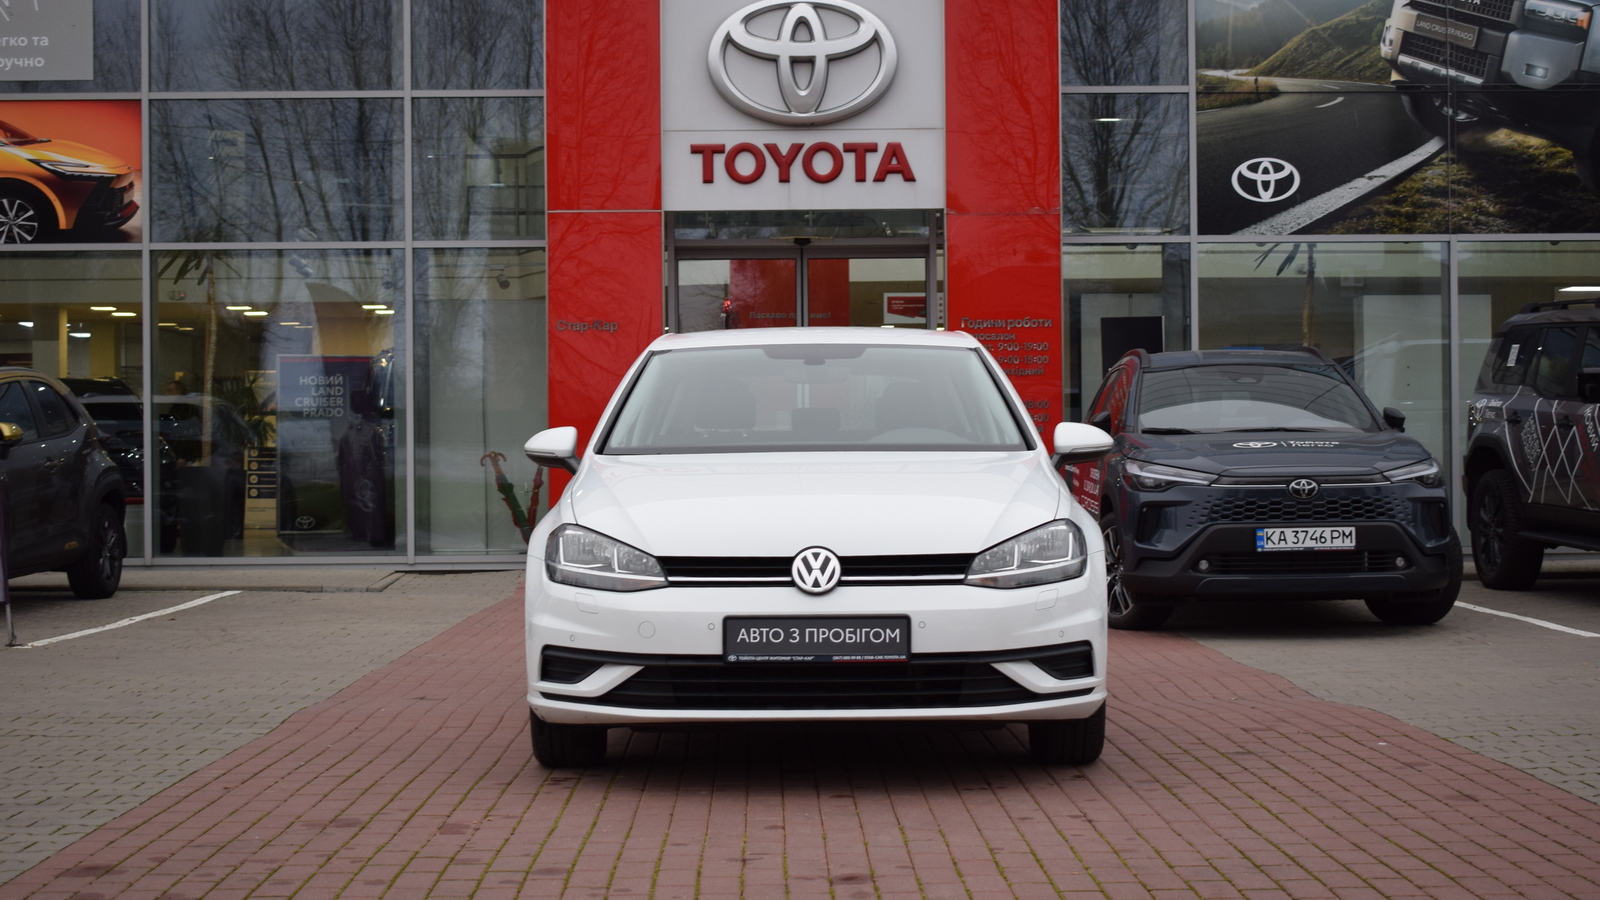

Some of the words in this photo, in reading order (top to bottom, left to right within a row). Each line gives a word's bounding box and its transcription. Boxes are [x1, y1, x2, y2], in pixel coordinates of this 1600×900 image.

[0, 37, 28, 46] гко
[32, 36, 49, 46] та
[690, 141, 917, 184] TOYOTA
[556, 320, 619, 333] Стар-Кар
[961, 317, 1006, 330] Години
[1007, 317, 1052, 330] роботи
[1003, 366, 1045, 376] ихідний
[299, 373, 344, 386] НОВИЙ
[311, 386, 344, 396] LAND
[294, 397, 344, 407] CRUISER
[302, 408, 344, 418] PRADO
[1265, 530, 1288, 546] KA
[1291, 529, 1327, 545] 3746
[1330, 529, 1353, 544] PM
[737, 627, 784, 643] АВТО
[805, 627, 900, 643] ПРОБІГОМ
